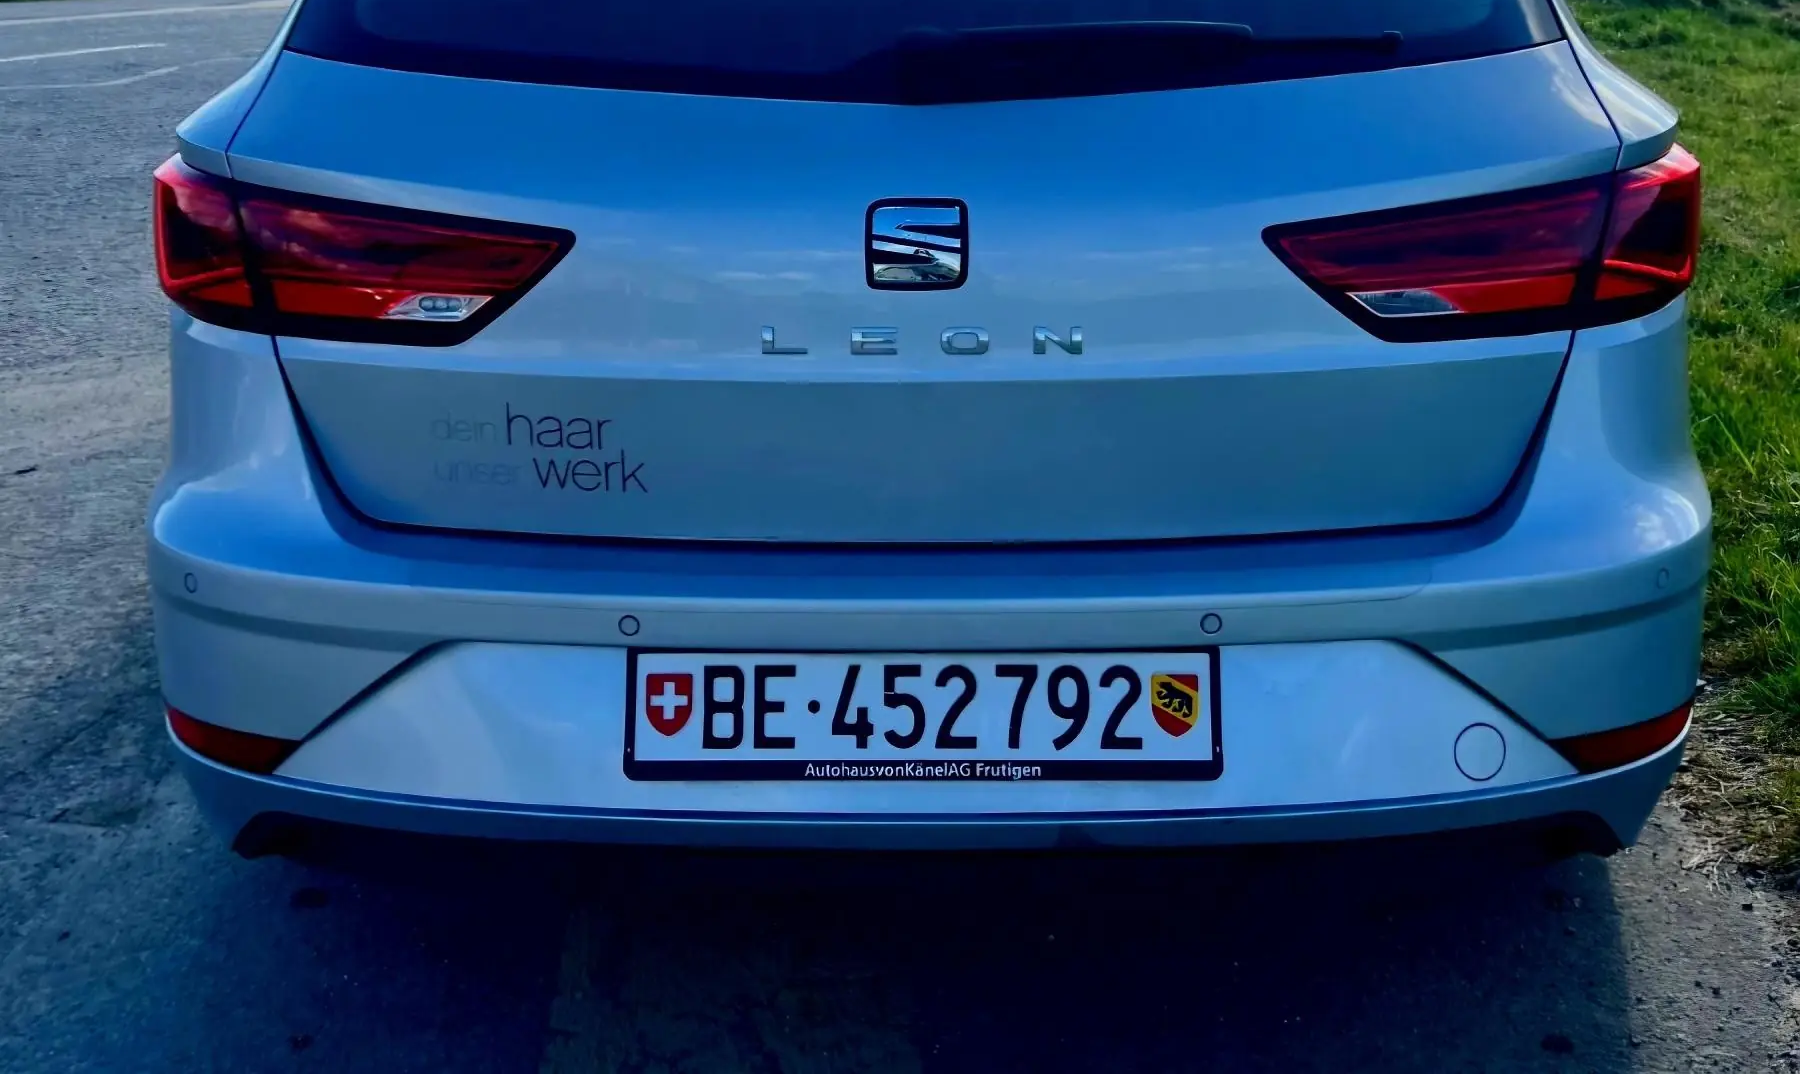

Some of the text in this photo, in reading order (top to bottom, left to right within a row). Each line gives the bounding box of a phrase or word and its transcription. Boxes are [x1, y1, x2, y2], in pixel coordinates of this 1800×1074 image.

[761, 326, 1083, 355] LEON
[505, 401, 612, 450] haar
[532, 449, 648, 493] werk
[975, 763, 1042, 781] Frutigen
